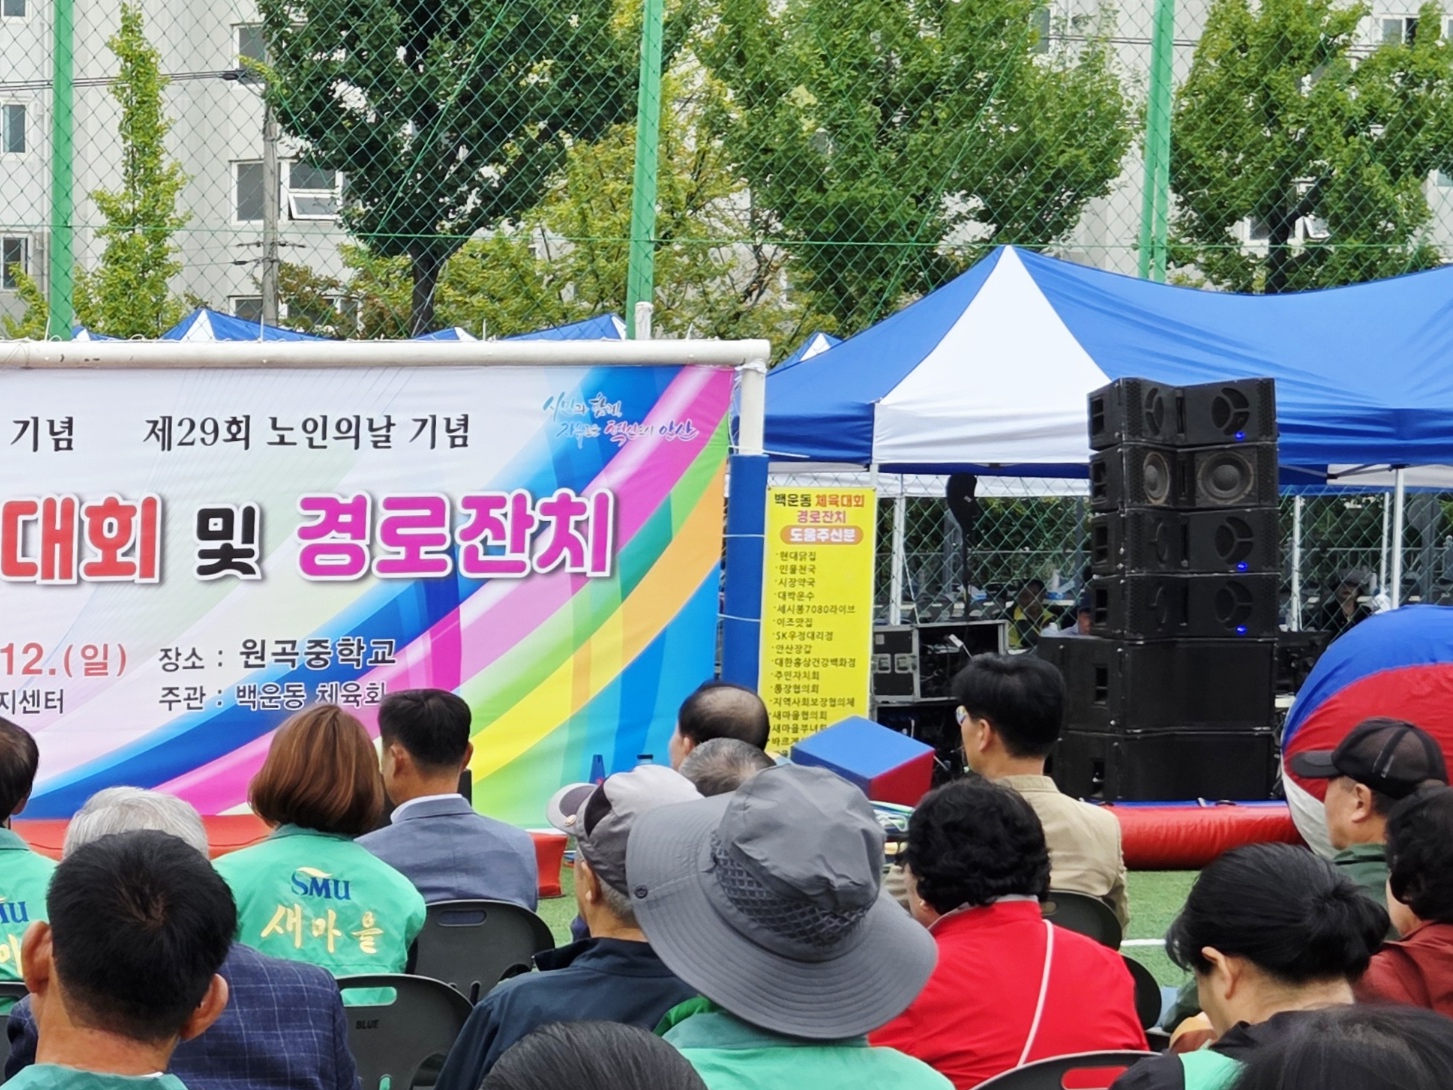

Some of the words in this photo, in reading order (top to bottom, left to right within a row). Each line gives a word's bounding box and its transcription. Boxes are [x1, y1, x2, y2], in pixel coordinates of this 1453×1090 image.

[10, 416, 75, 453] 기념
[142, 414, 251, 452] 제29회
[265, 413, 397, 451] 노인의날
[408, 413, 471, 449] 기념
[658, 418, 700, 441] 안산
[774, 493, 812, 507] 백운동
[815, 494, 865, 508] 체육대회
[797, 510, 847, 523] 경로잔치
[194, 503, 262, 580] 및
[294, 489, 615, 579] 경로잔치
[789, 527, 856, 543] 도움주신분
[158, 646, 206, 673] 장소
[238, 637, 397, 670] 원곡중학교
[158, 685, 207, 711] 주관
[236, 683, 307, 711] 백운동
[316, 681, 387, 709] 체육회
[291, 871, 353, 901] SMU
[260, 903, 389, 956] 새마을
